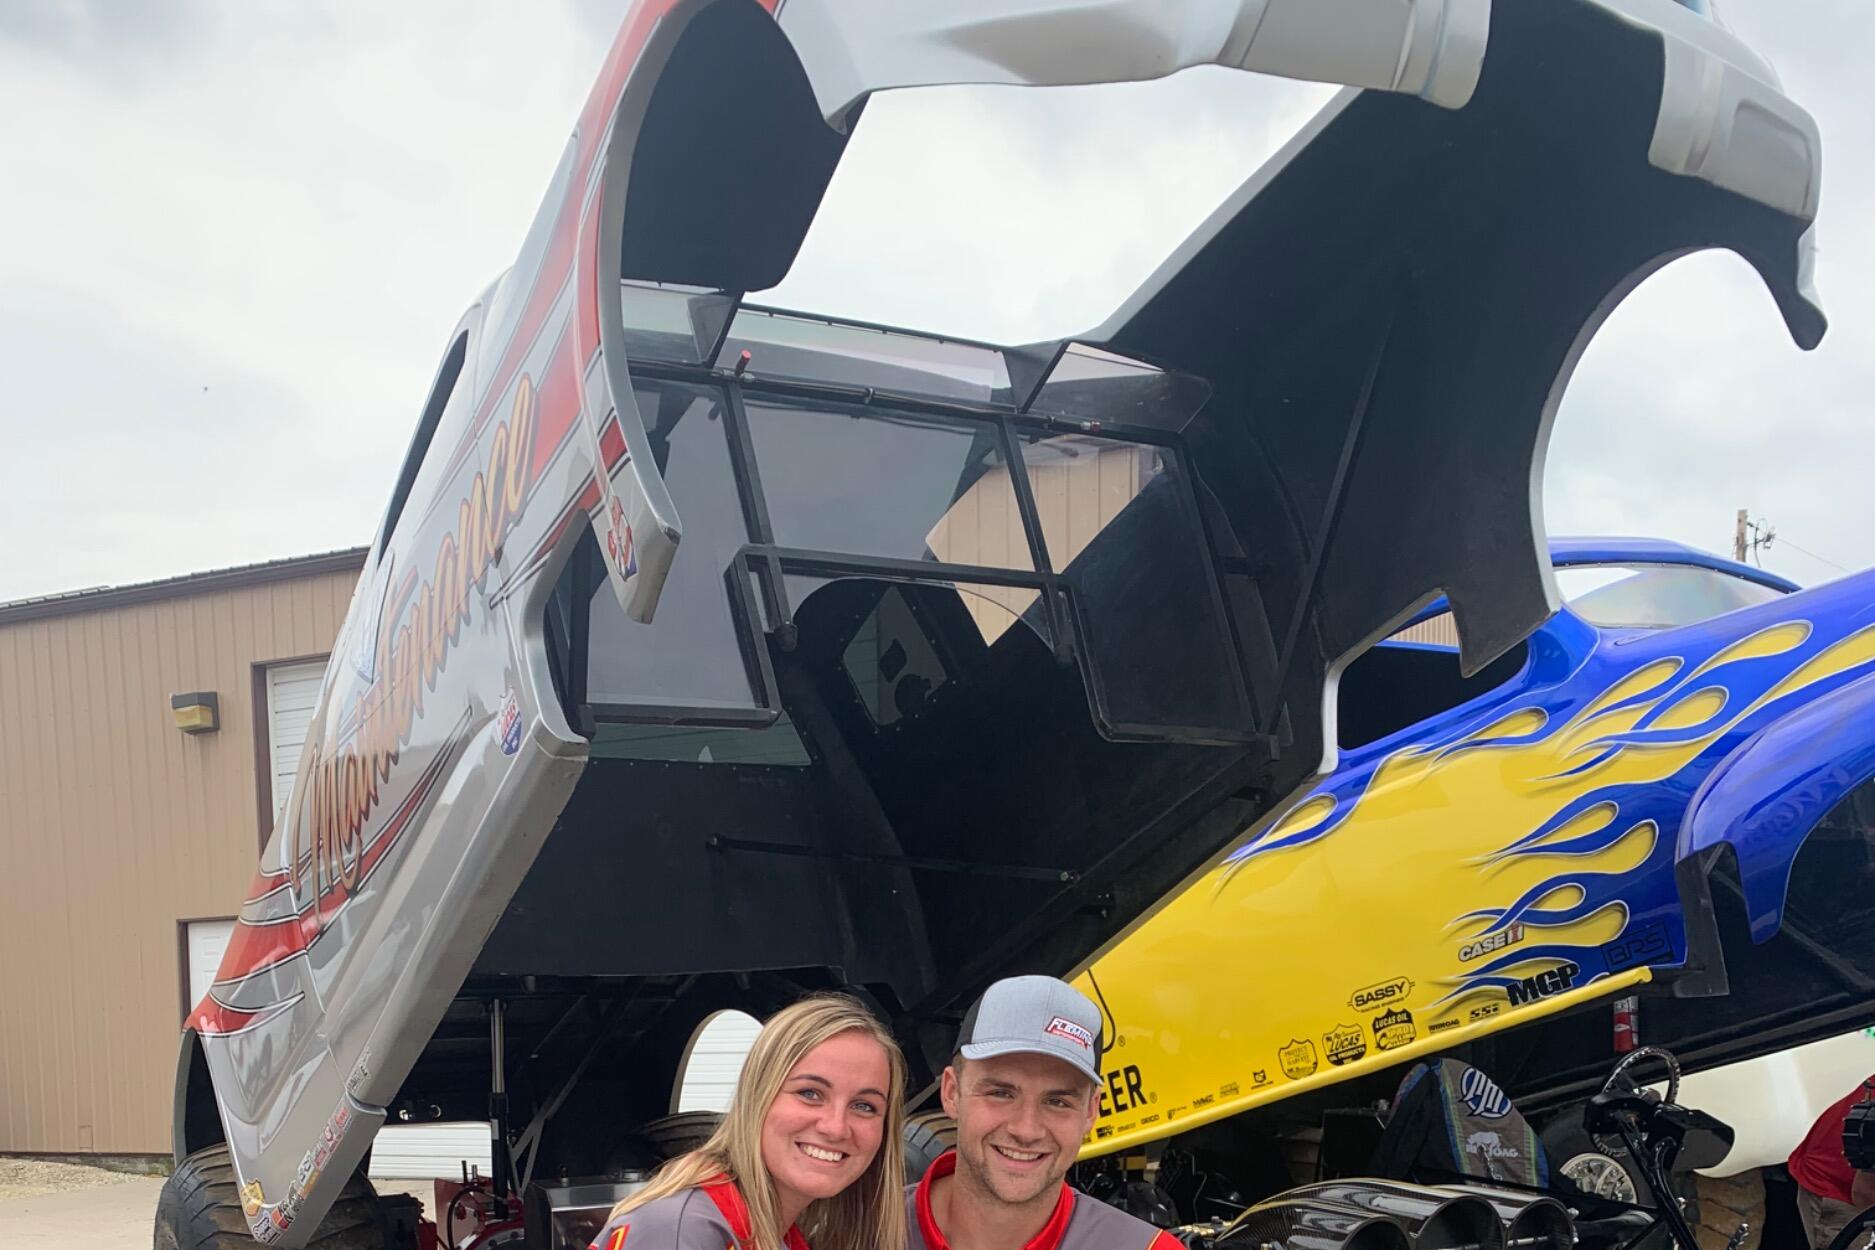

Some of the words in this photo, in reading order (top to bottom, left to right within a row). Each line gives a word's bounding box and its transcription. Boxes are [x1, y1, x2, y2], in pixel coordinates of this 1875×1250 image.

[1354, 981, 1406, 1008] SASSY
[1506, 963, 1580, 1007] MGP
[1374, 1015, 1397, 1029] LUCAS
